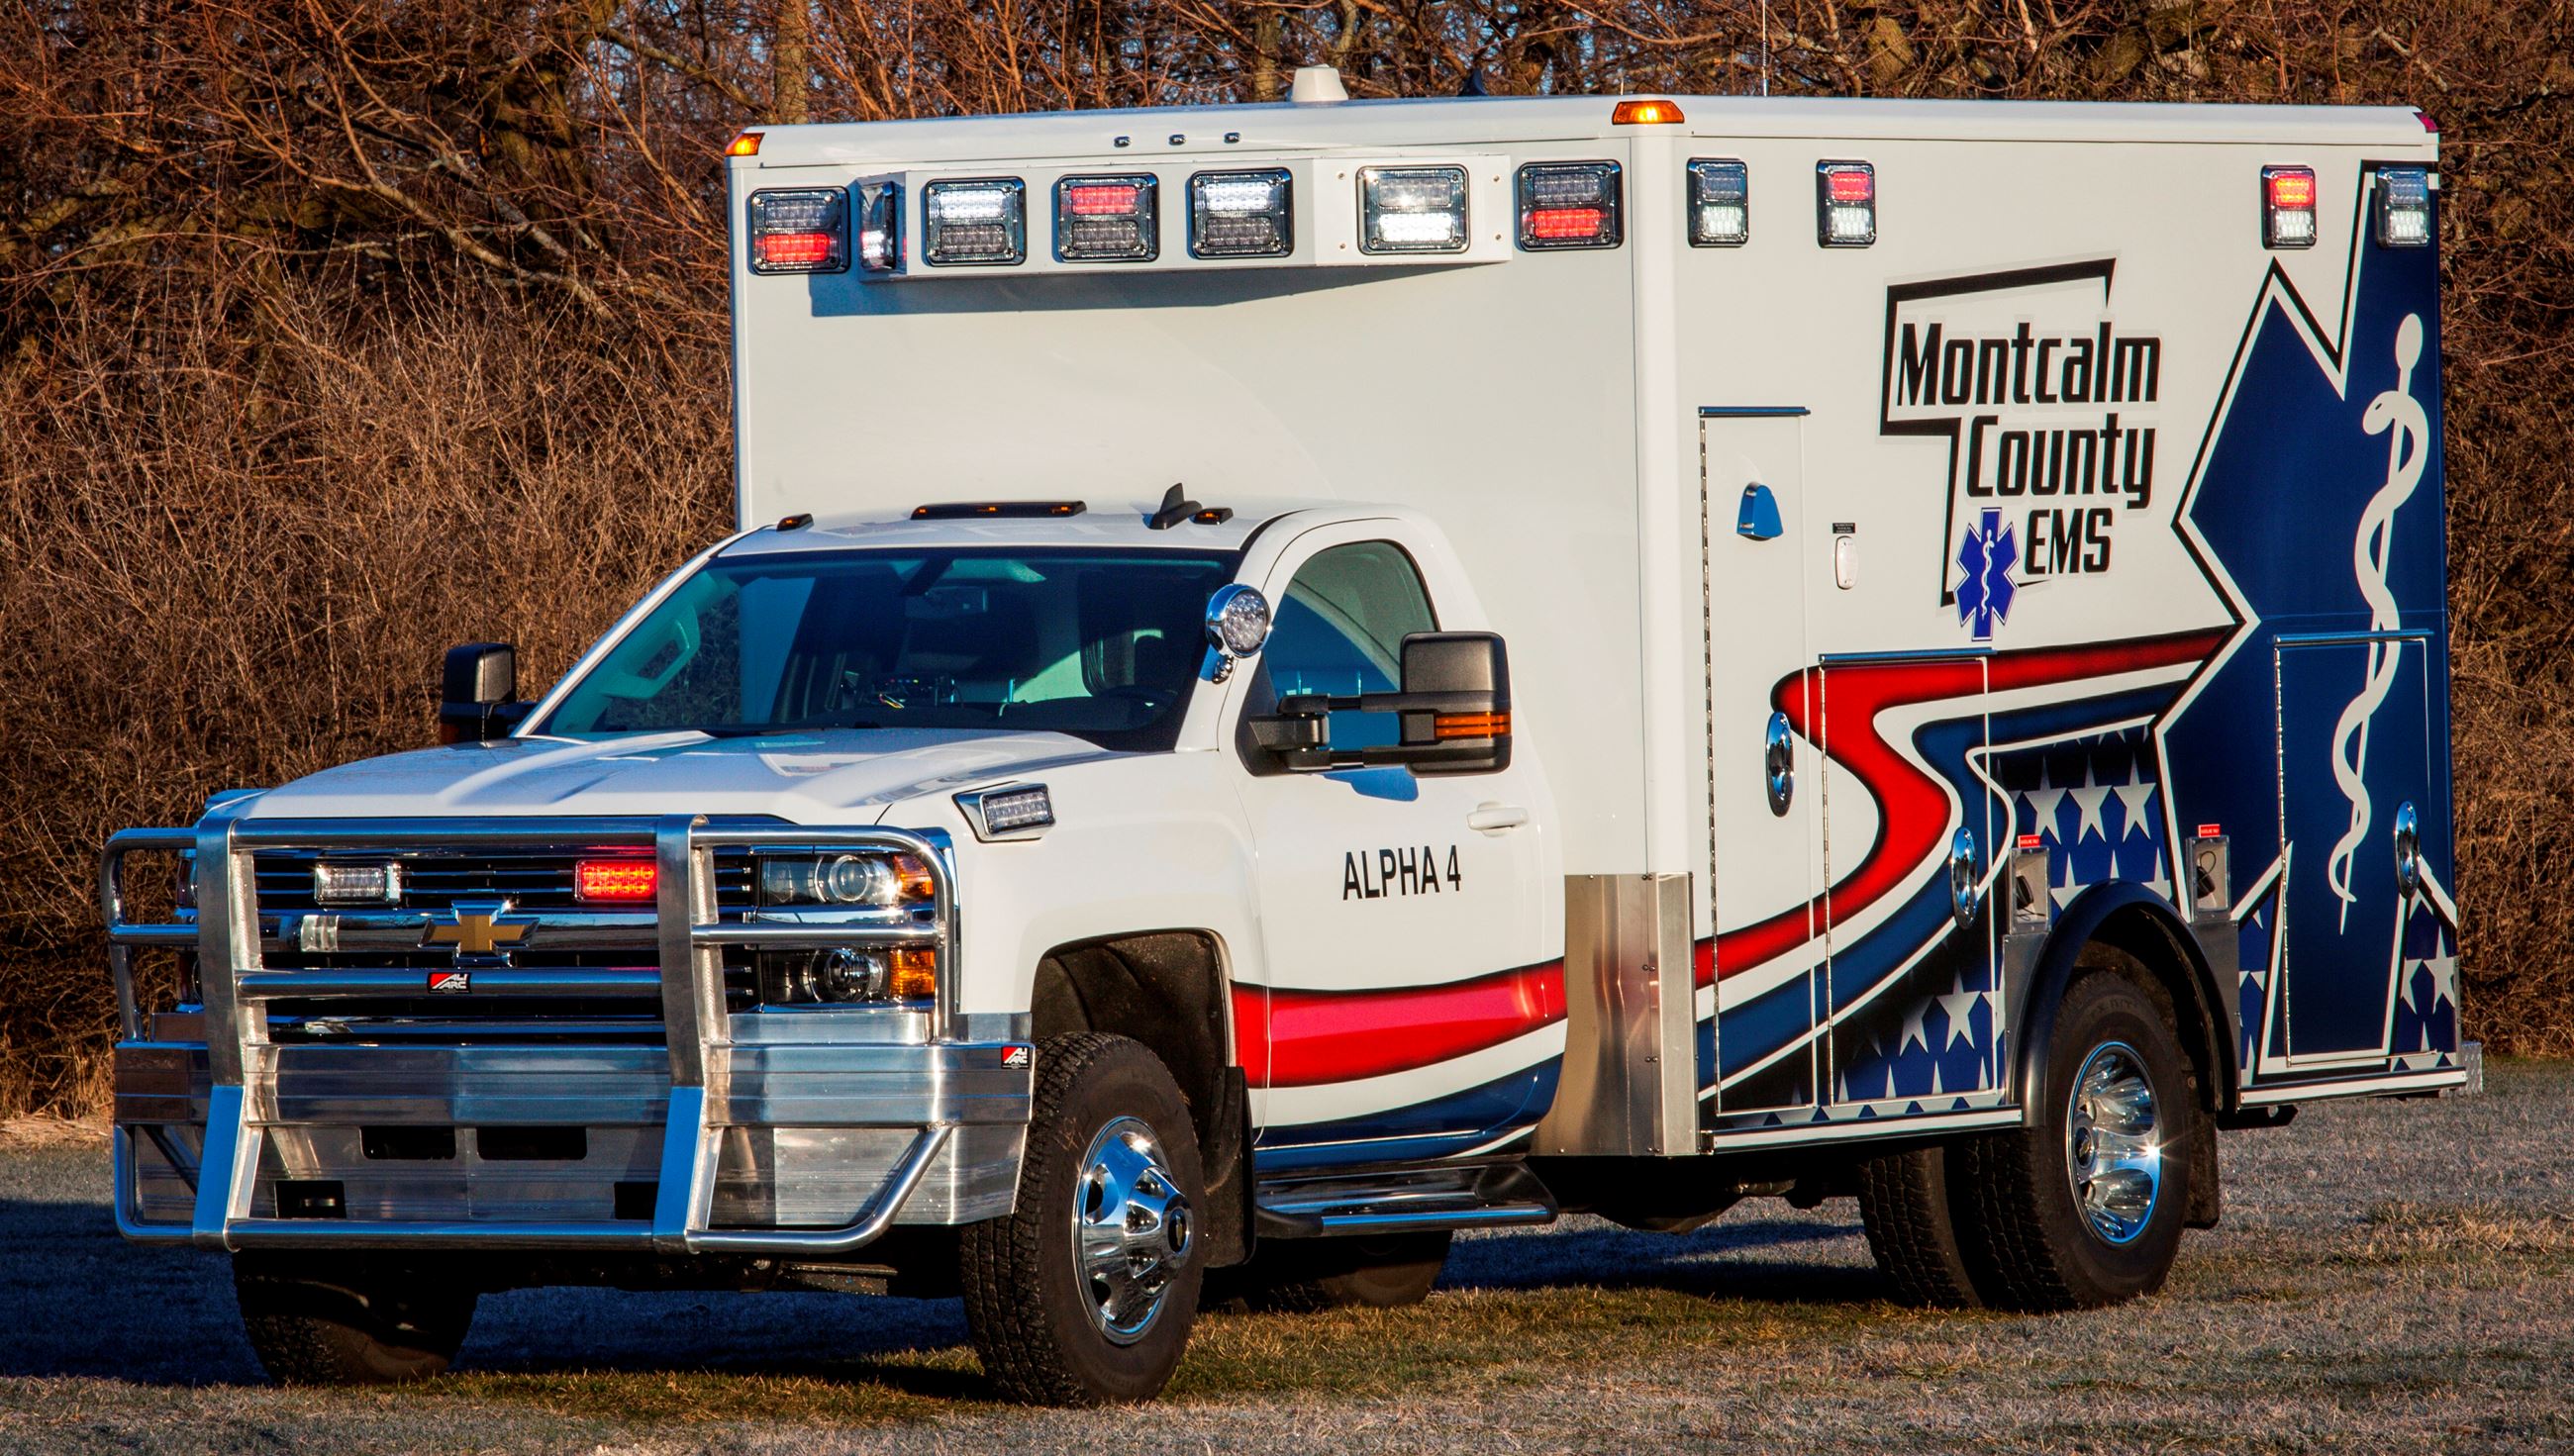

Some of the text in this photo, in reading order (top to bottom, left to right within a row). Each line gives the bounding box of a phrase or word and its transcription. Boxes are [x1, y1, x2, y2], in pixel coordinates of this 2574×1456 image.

[1897, 321, 2161, 407] Montcalm
[1966, 413, 2156, 510] County
[2024, 507, 2114, 575] EMS
[1342, 844, 1461, 901] ALPHA 4
